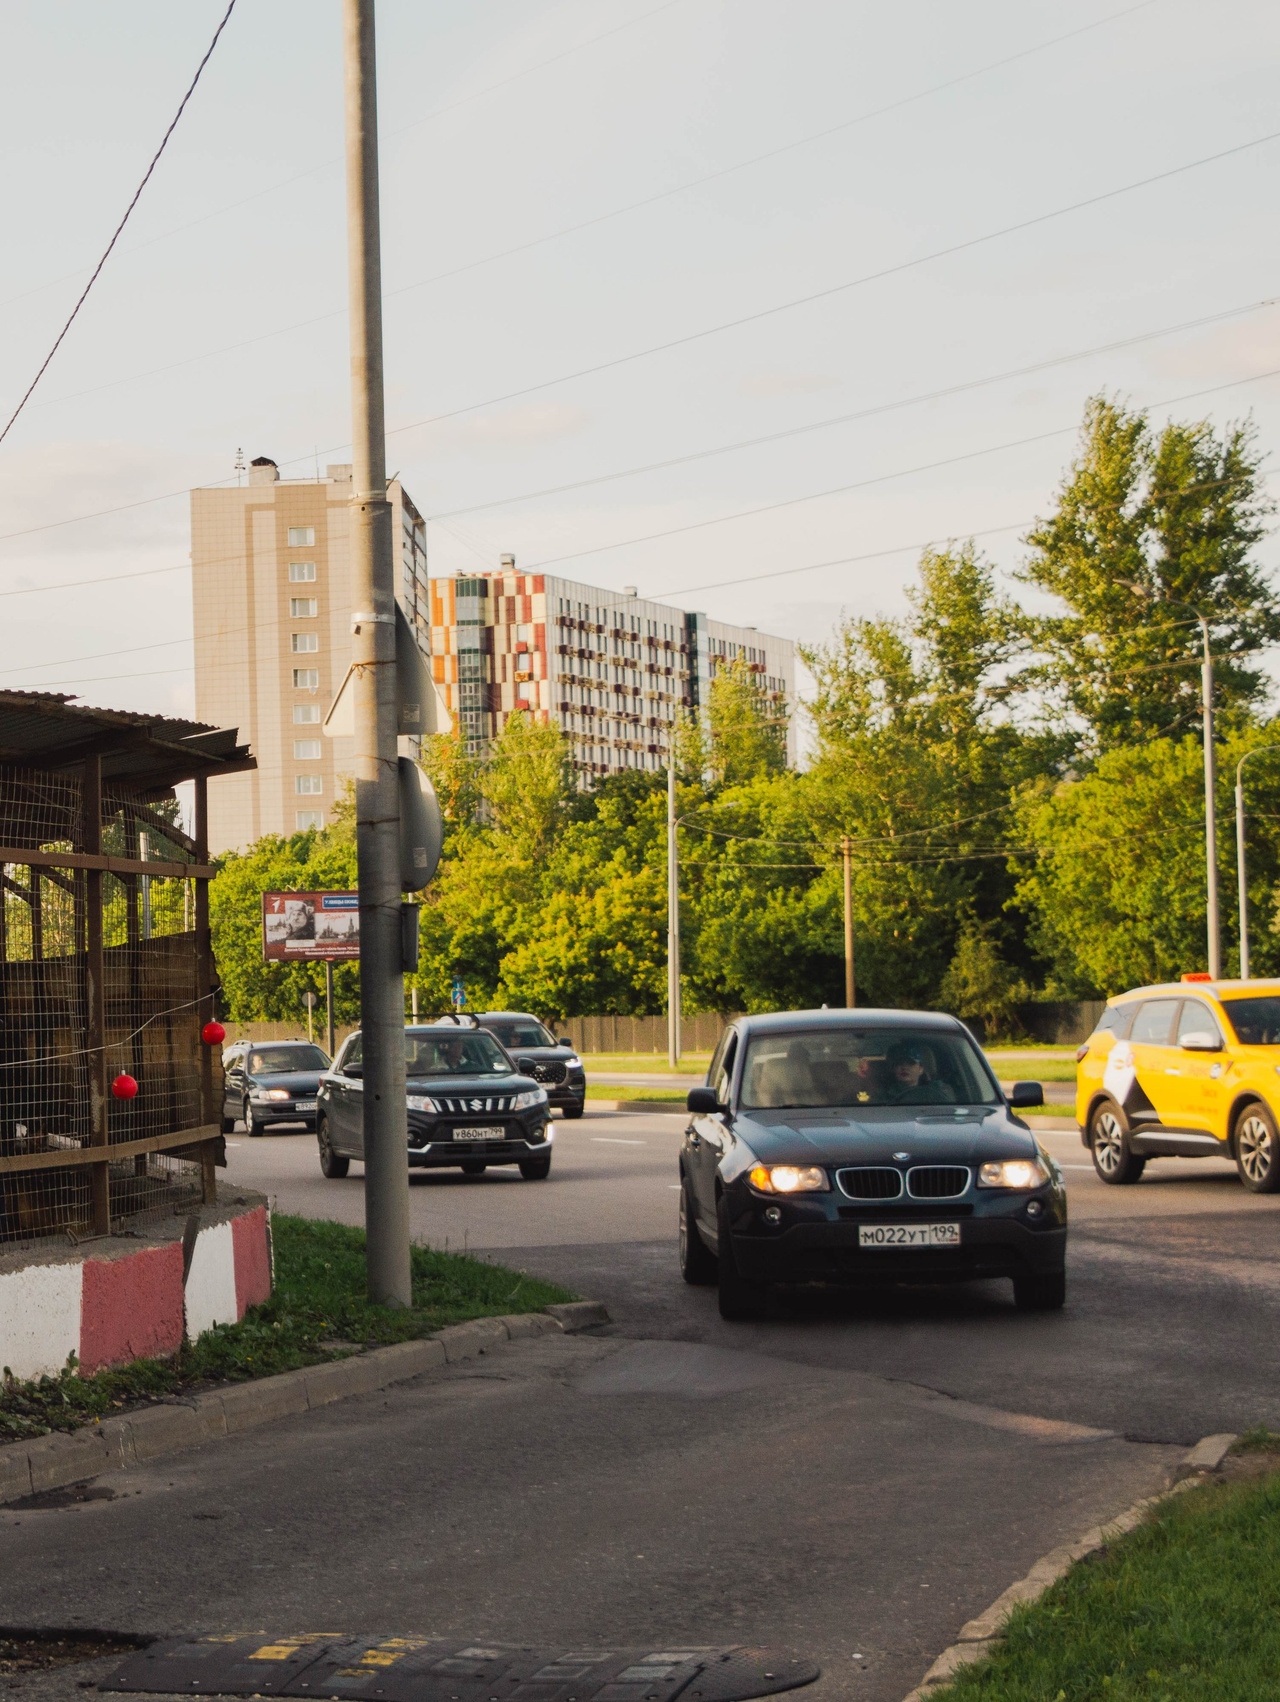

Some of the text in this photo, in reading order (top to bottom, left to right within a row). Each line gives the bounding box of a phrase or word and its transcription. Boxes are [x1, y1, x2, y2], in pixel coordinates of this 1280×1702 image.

[455, 1129, 488, 1139] У860НТ
[863, 1225, 955, 1243] М022УТ 199
